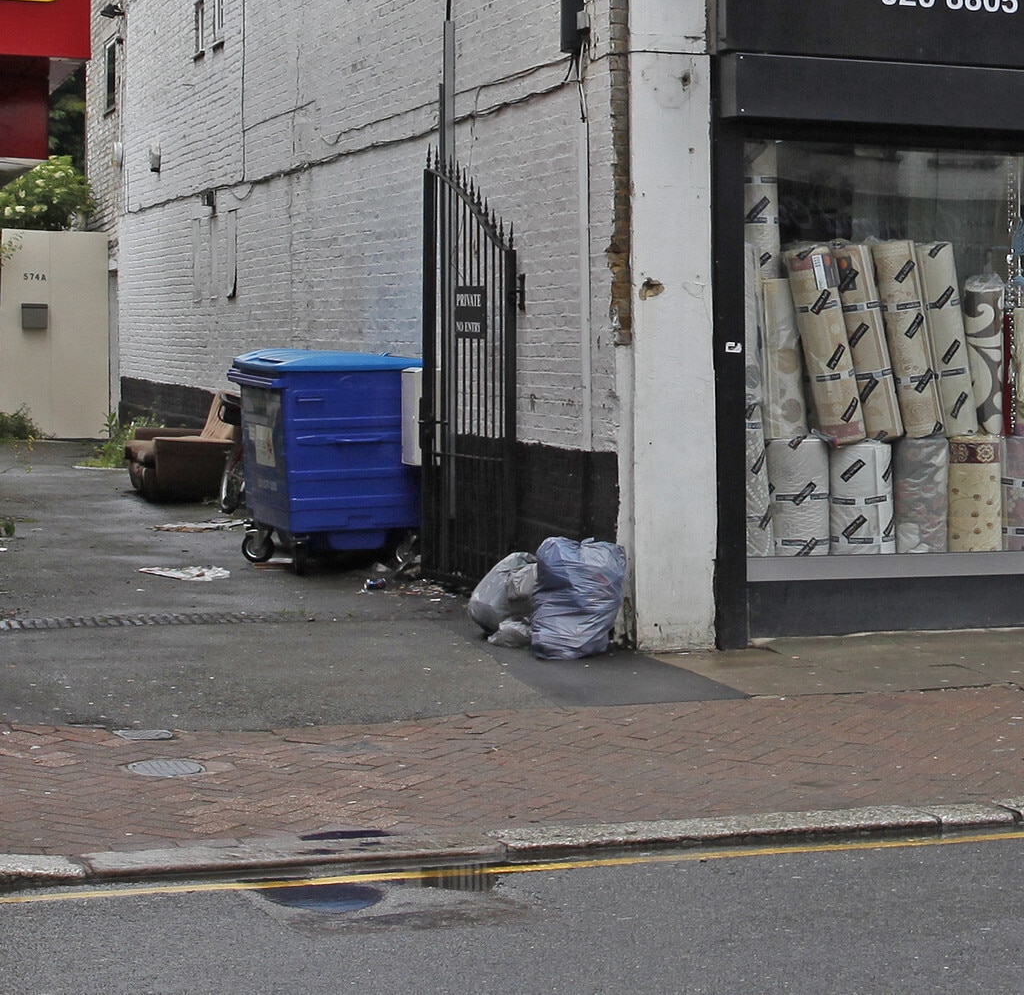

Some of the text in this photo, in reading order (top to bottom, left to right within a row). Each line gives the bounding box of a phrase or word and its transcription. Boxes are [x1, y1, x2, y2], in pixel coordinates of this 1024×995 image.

[23, 272, 47, 281] 574A
[456, 293, 482, 307] PRIVATE
[456, 321, 481, 333] NO ENTRY
